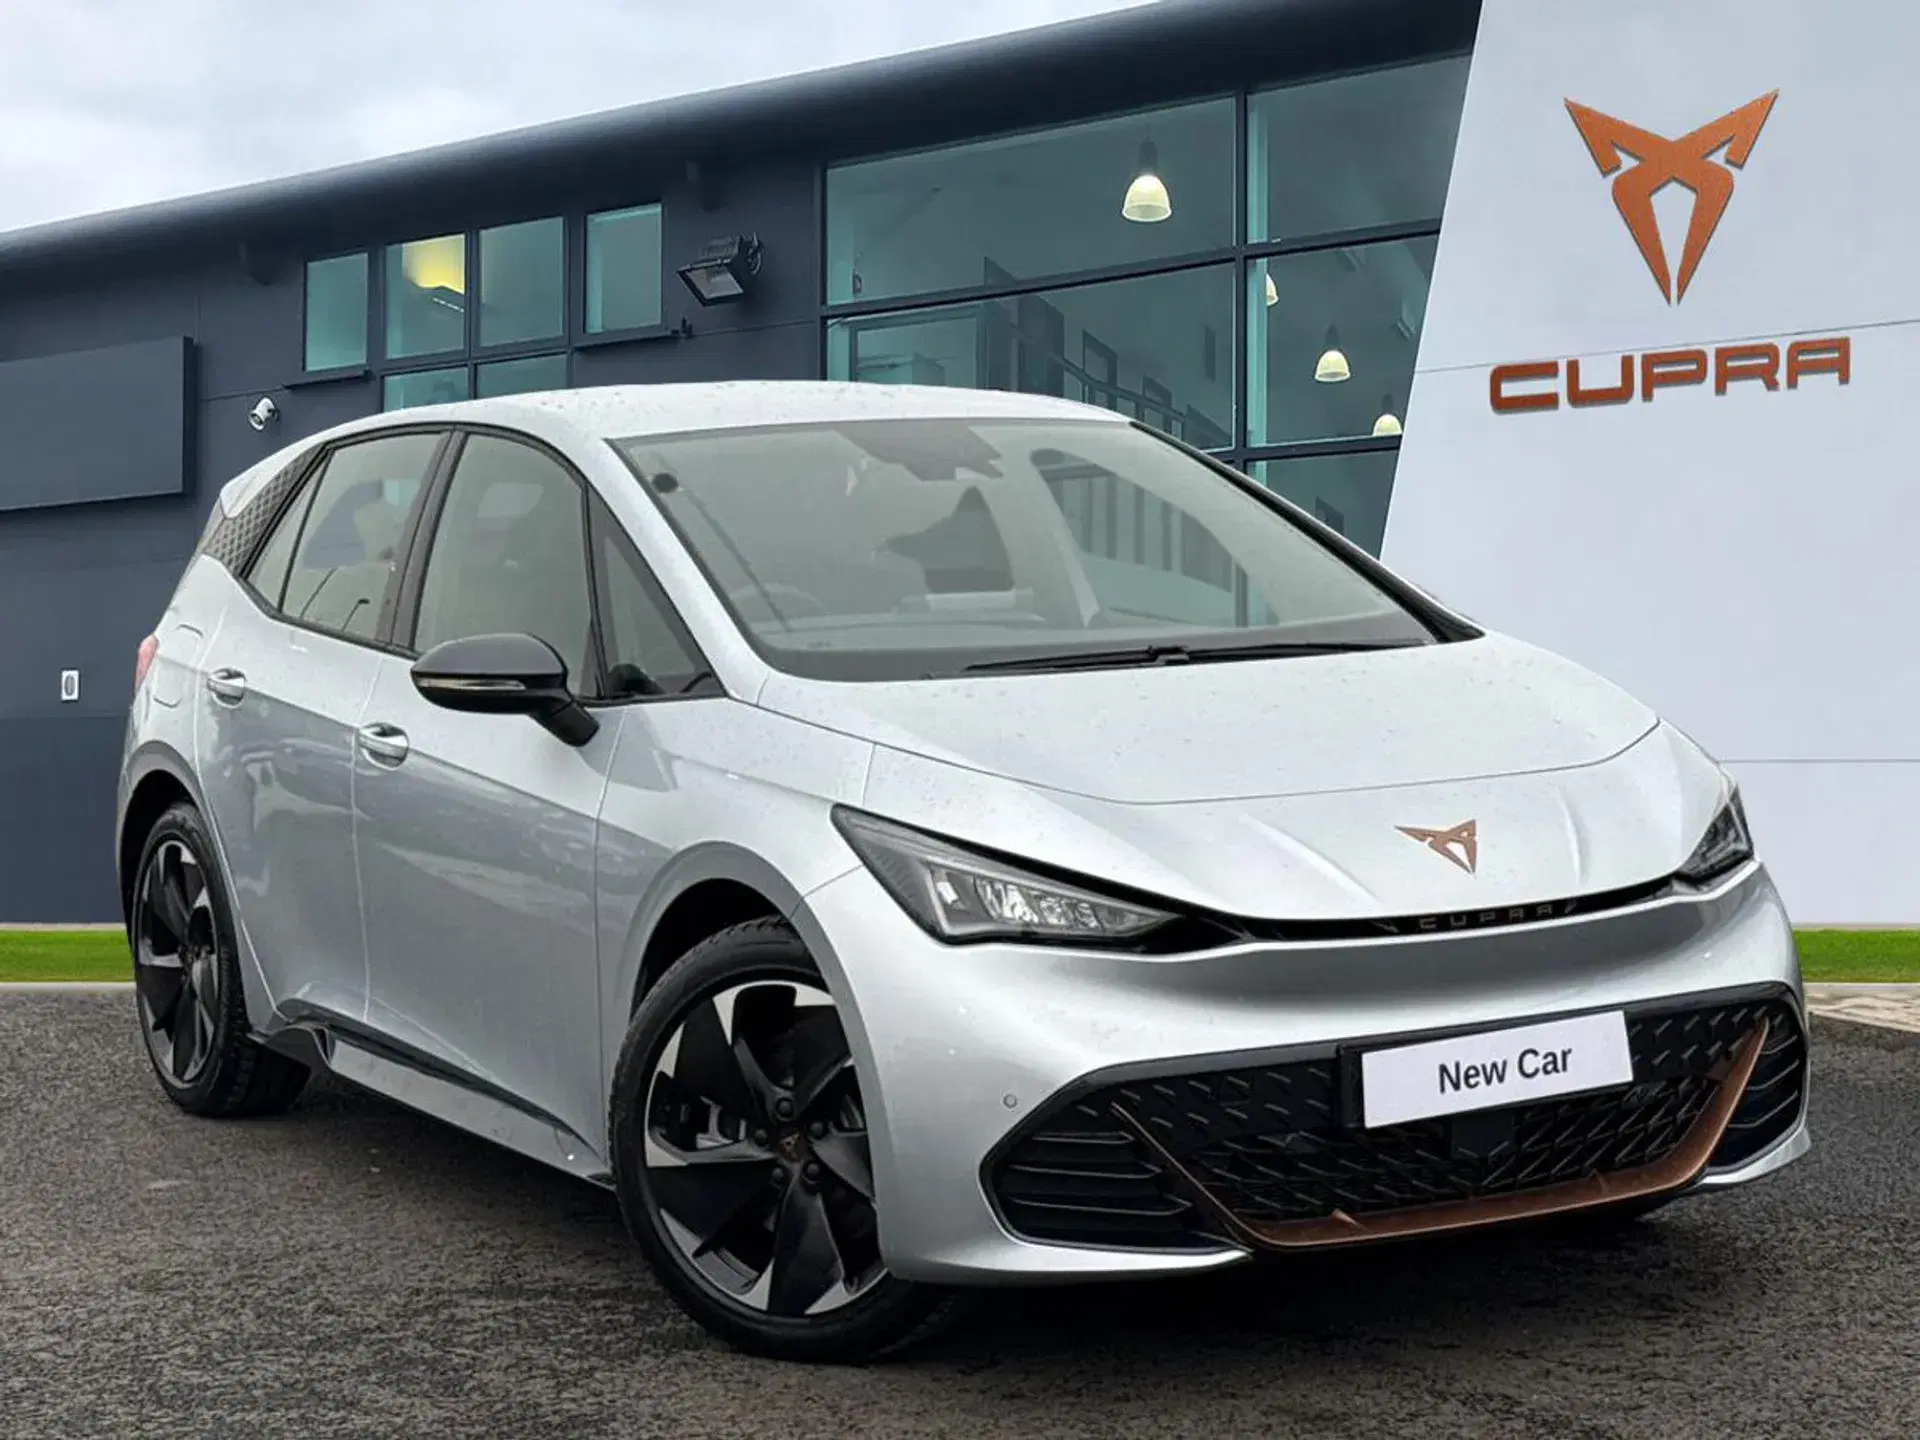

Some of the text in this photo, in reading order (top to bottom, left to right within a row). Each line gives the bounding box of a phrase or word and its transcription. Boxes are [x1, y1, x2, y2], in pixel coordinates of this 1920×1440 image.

[1489, 336, 1851, 414] CUPRA
[1418, 904, 1553, 929] CUPRA
[1438, 1048, 1573, 1094] New Car
